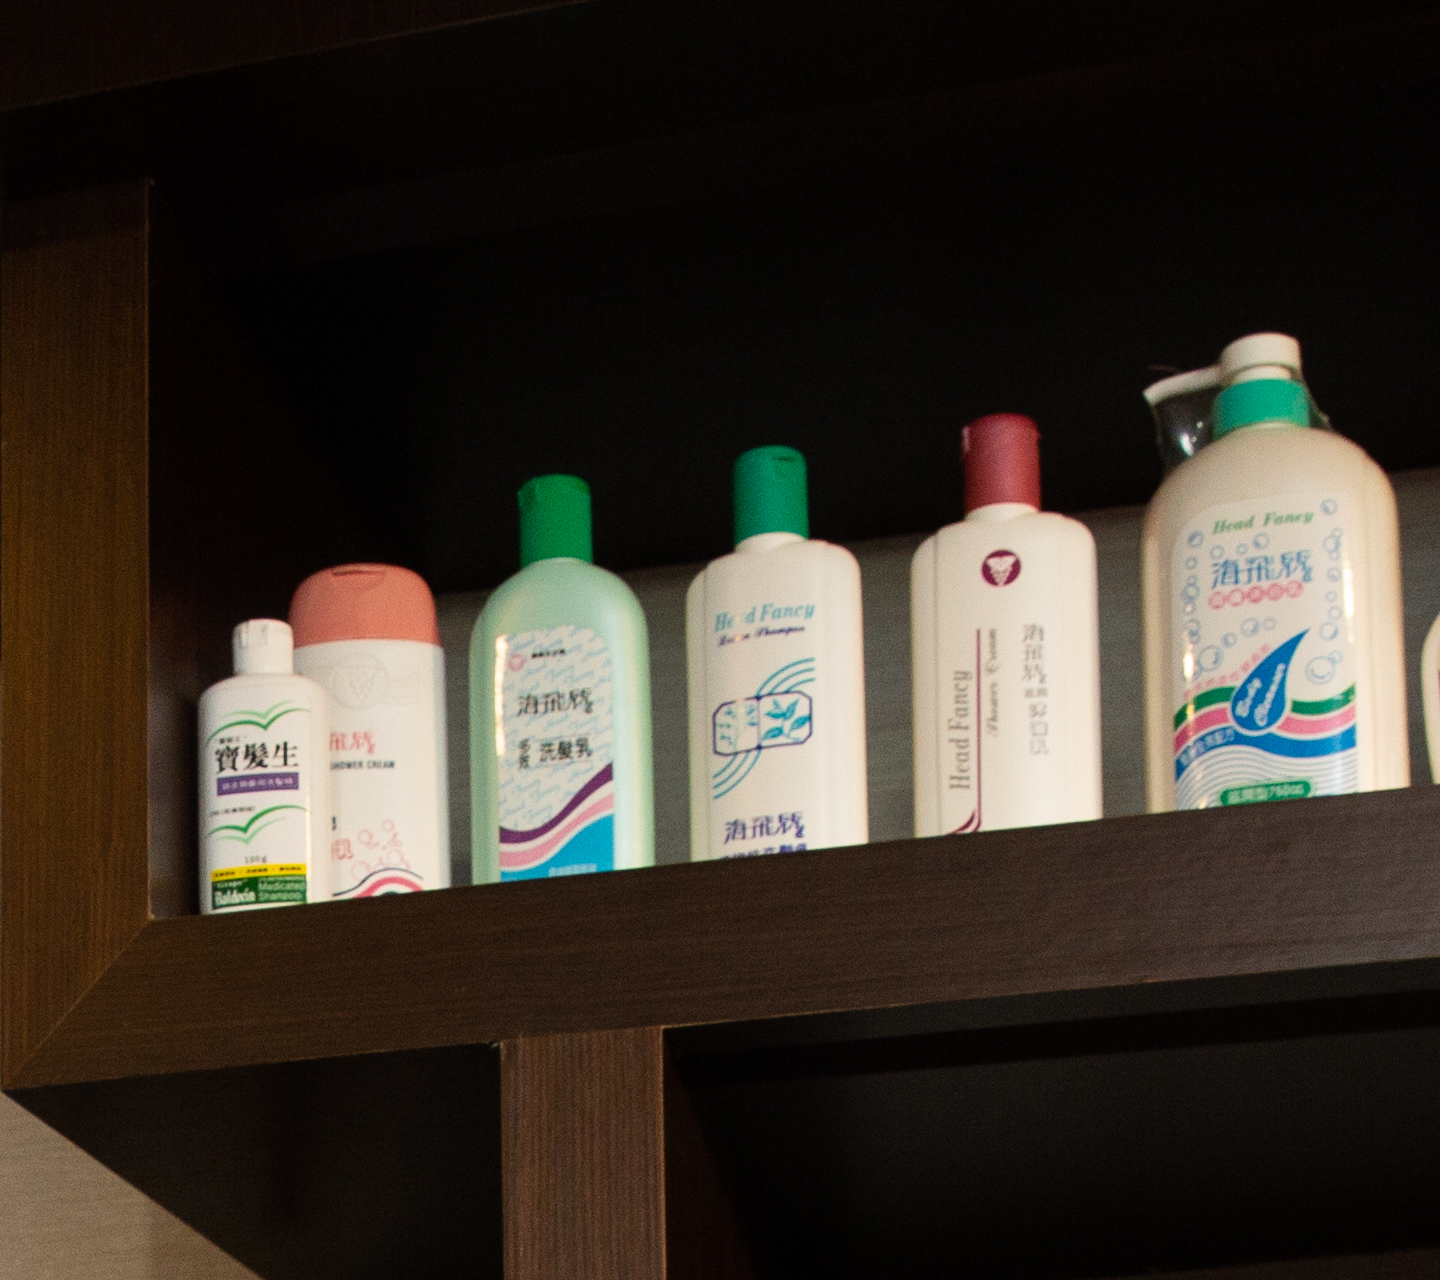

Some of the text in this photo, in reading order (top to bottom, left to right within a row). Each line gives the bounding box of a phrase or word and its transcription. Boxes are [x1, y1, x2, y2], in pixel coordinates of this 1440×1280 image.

[1213, 515, 1255, 534] Head
[714, 601, 816, 634] Hed Fancy
[948, 670, 973, 790] Head Fancy
[215, 741, 299, 775] 寶髮生
